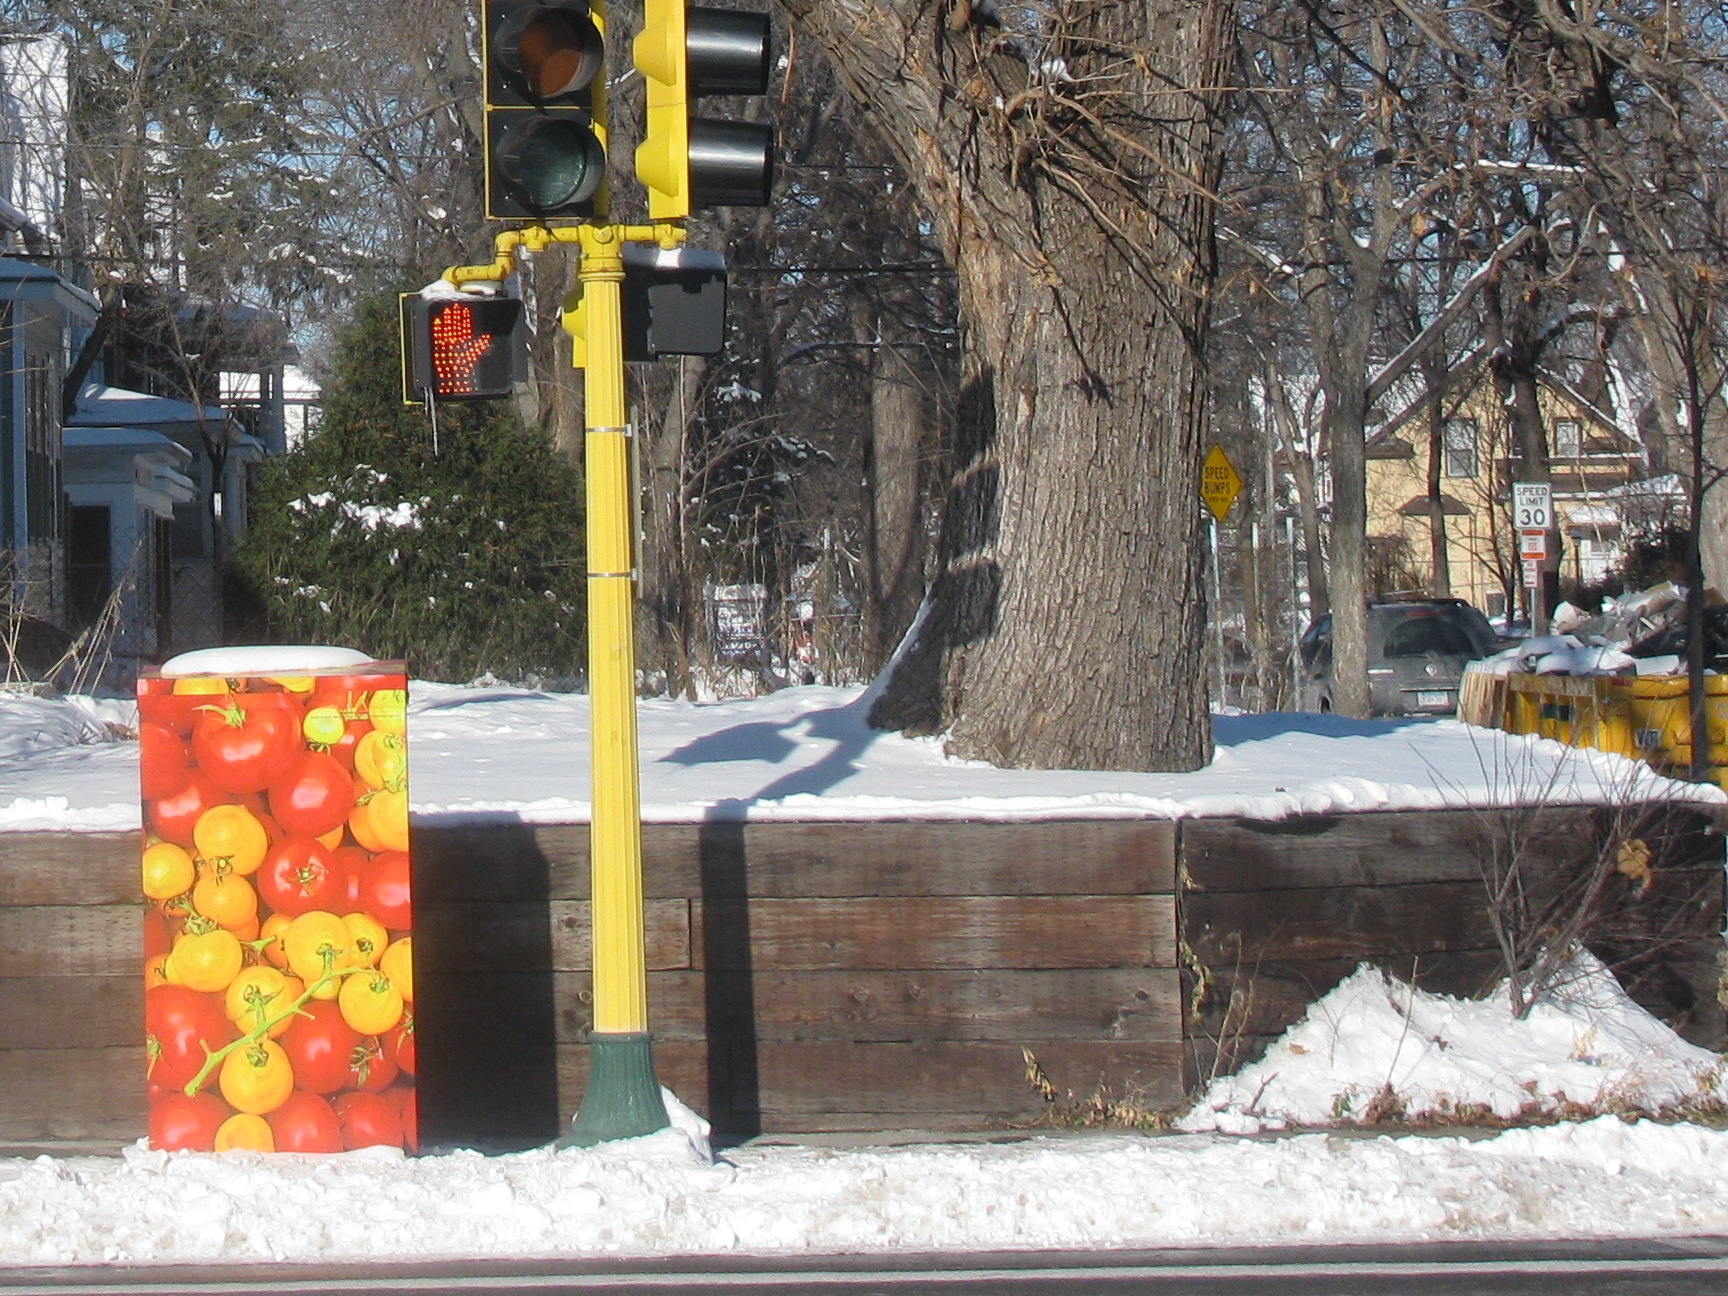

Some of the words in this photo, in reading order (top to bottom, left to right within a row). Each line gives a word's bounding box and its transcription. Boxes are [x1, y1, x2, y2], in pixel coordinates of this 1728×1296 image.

[1205, 467, 1229, 479] SPEED
[1205, 482, 1230, 494] BUMPS
[1516, 487, 1548, 496] SPEED
[1519, 497, 1544, 506] LIMIT
[1520, 509, 1545, 525] 30
